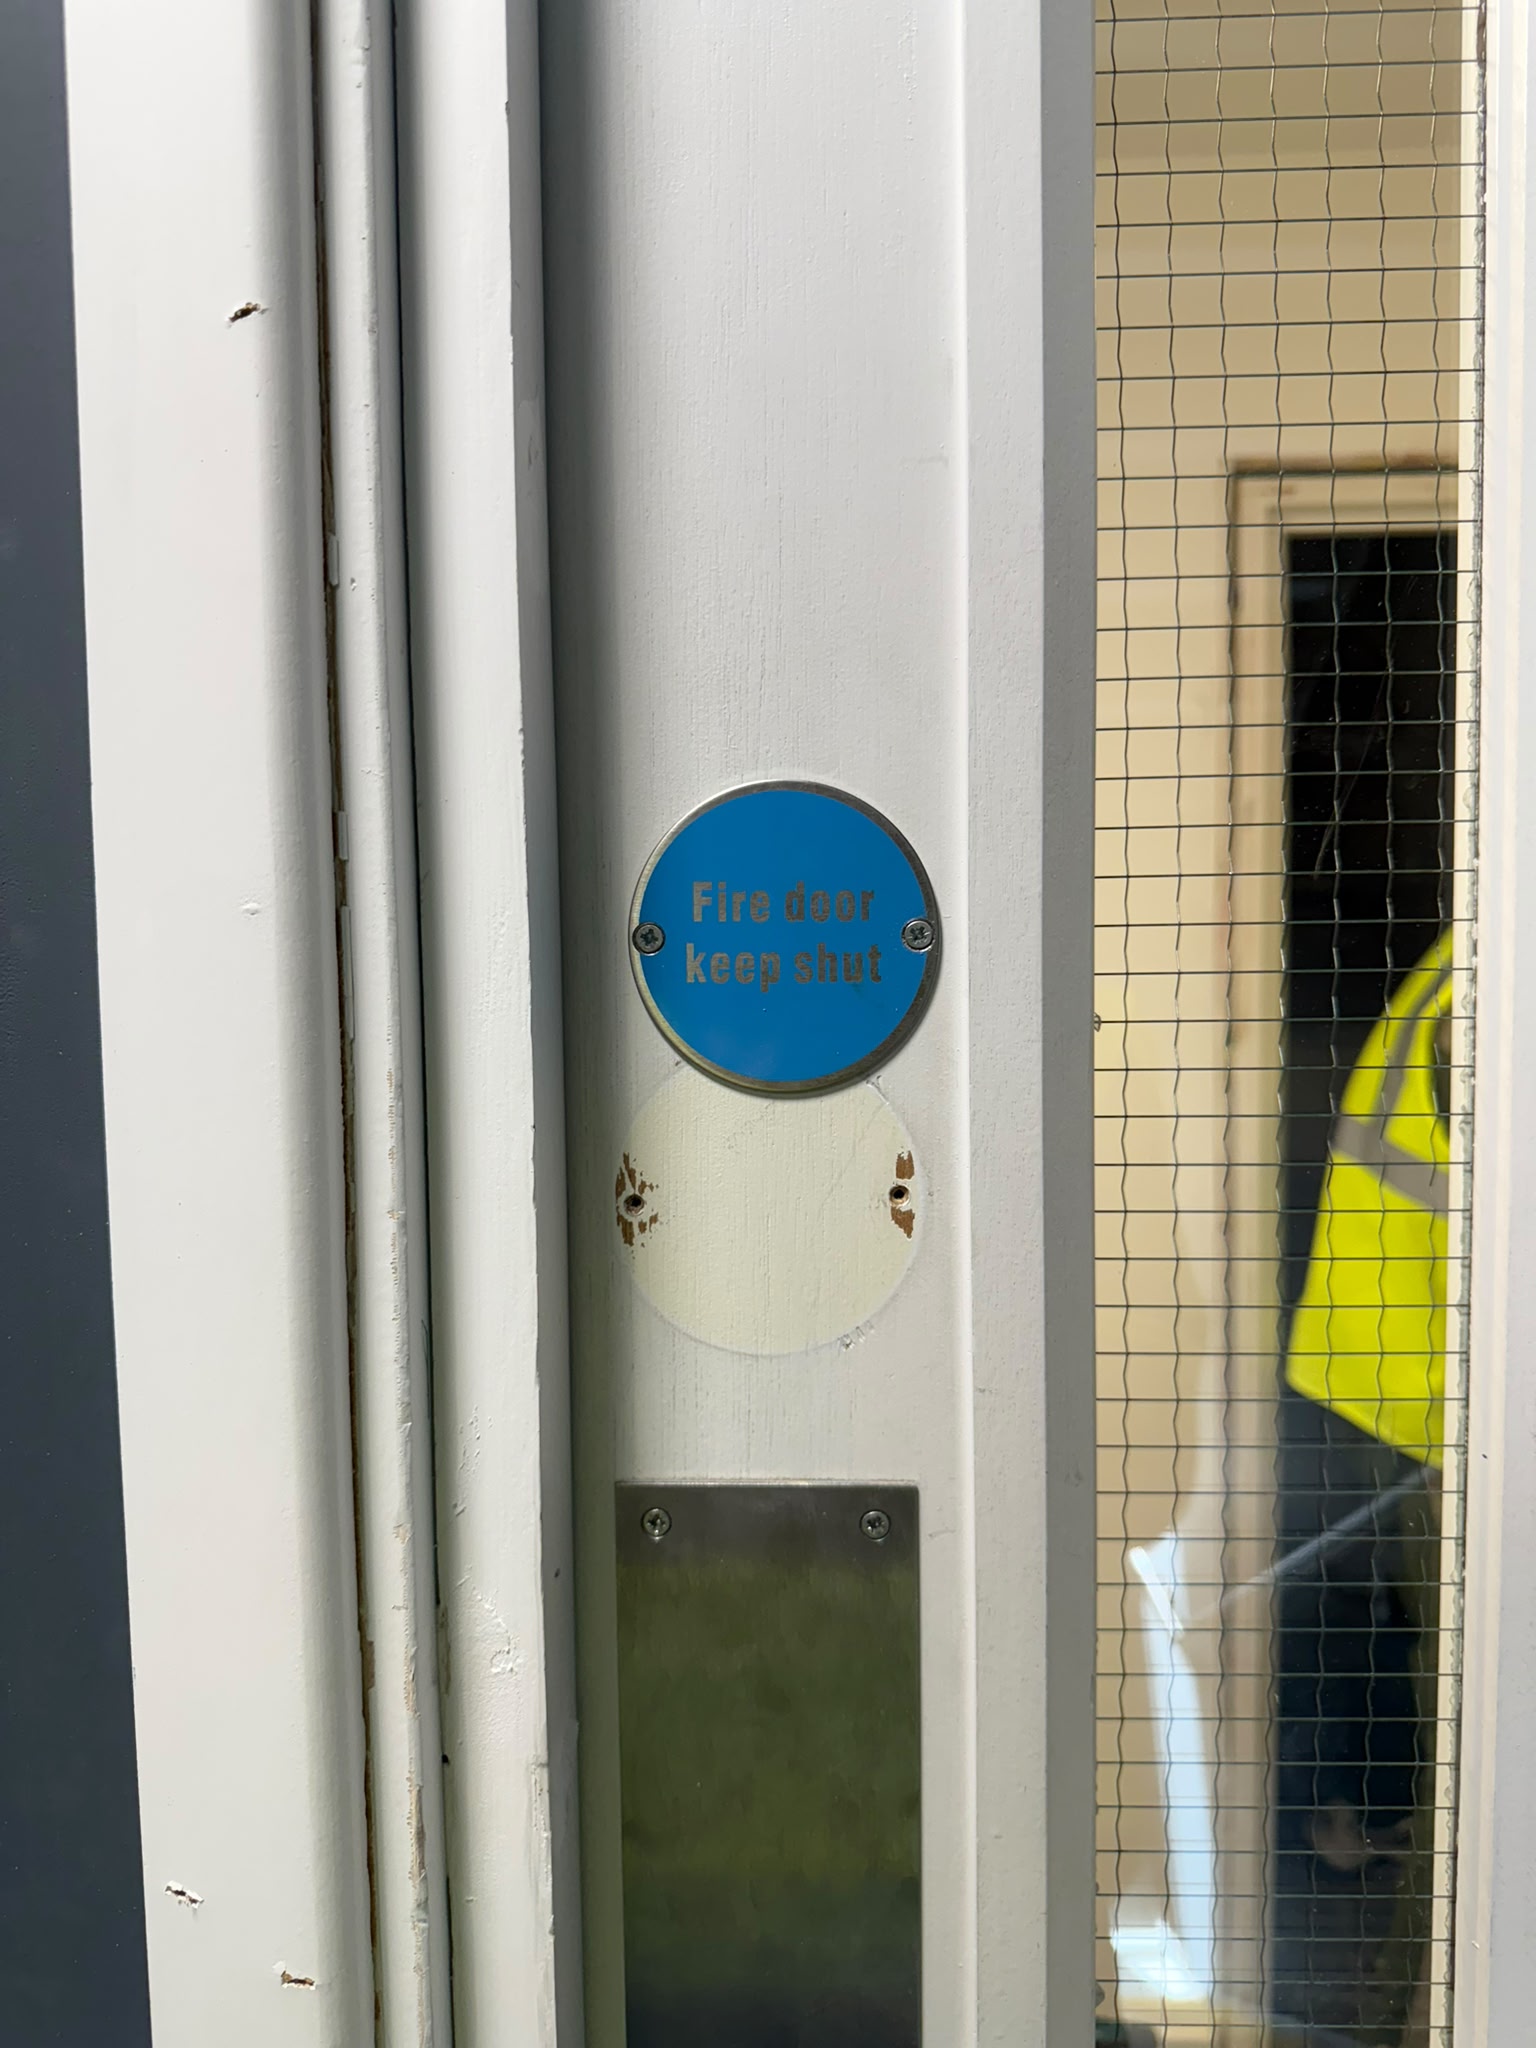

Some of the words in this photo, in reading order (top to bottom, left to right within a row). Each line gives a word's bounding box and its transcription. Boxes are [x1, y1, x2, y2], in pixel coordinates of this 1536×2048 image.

[693, 881, 770, 922] Fire
[785, 880, 874, 922] door
[686, 943, 780, 993] keep
[794, 942, 881, 984] shut
